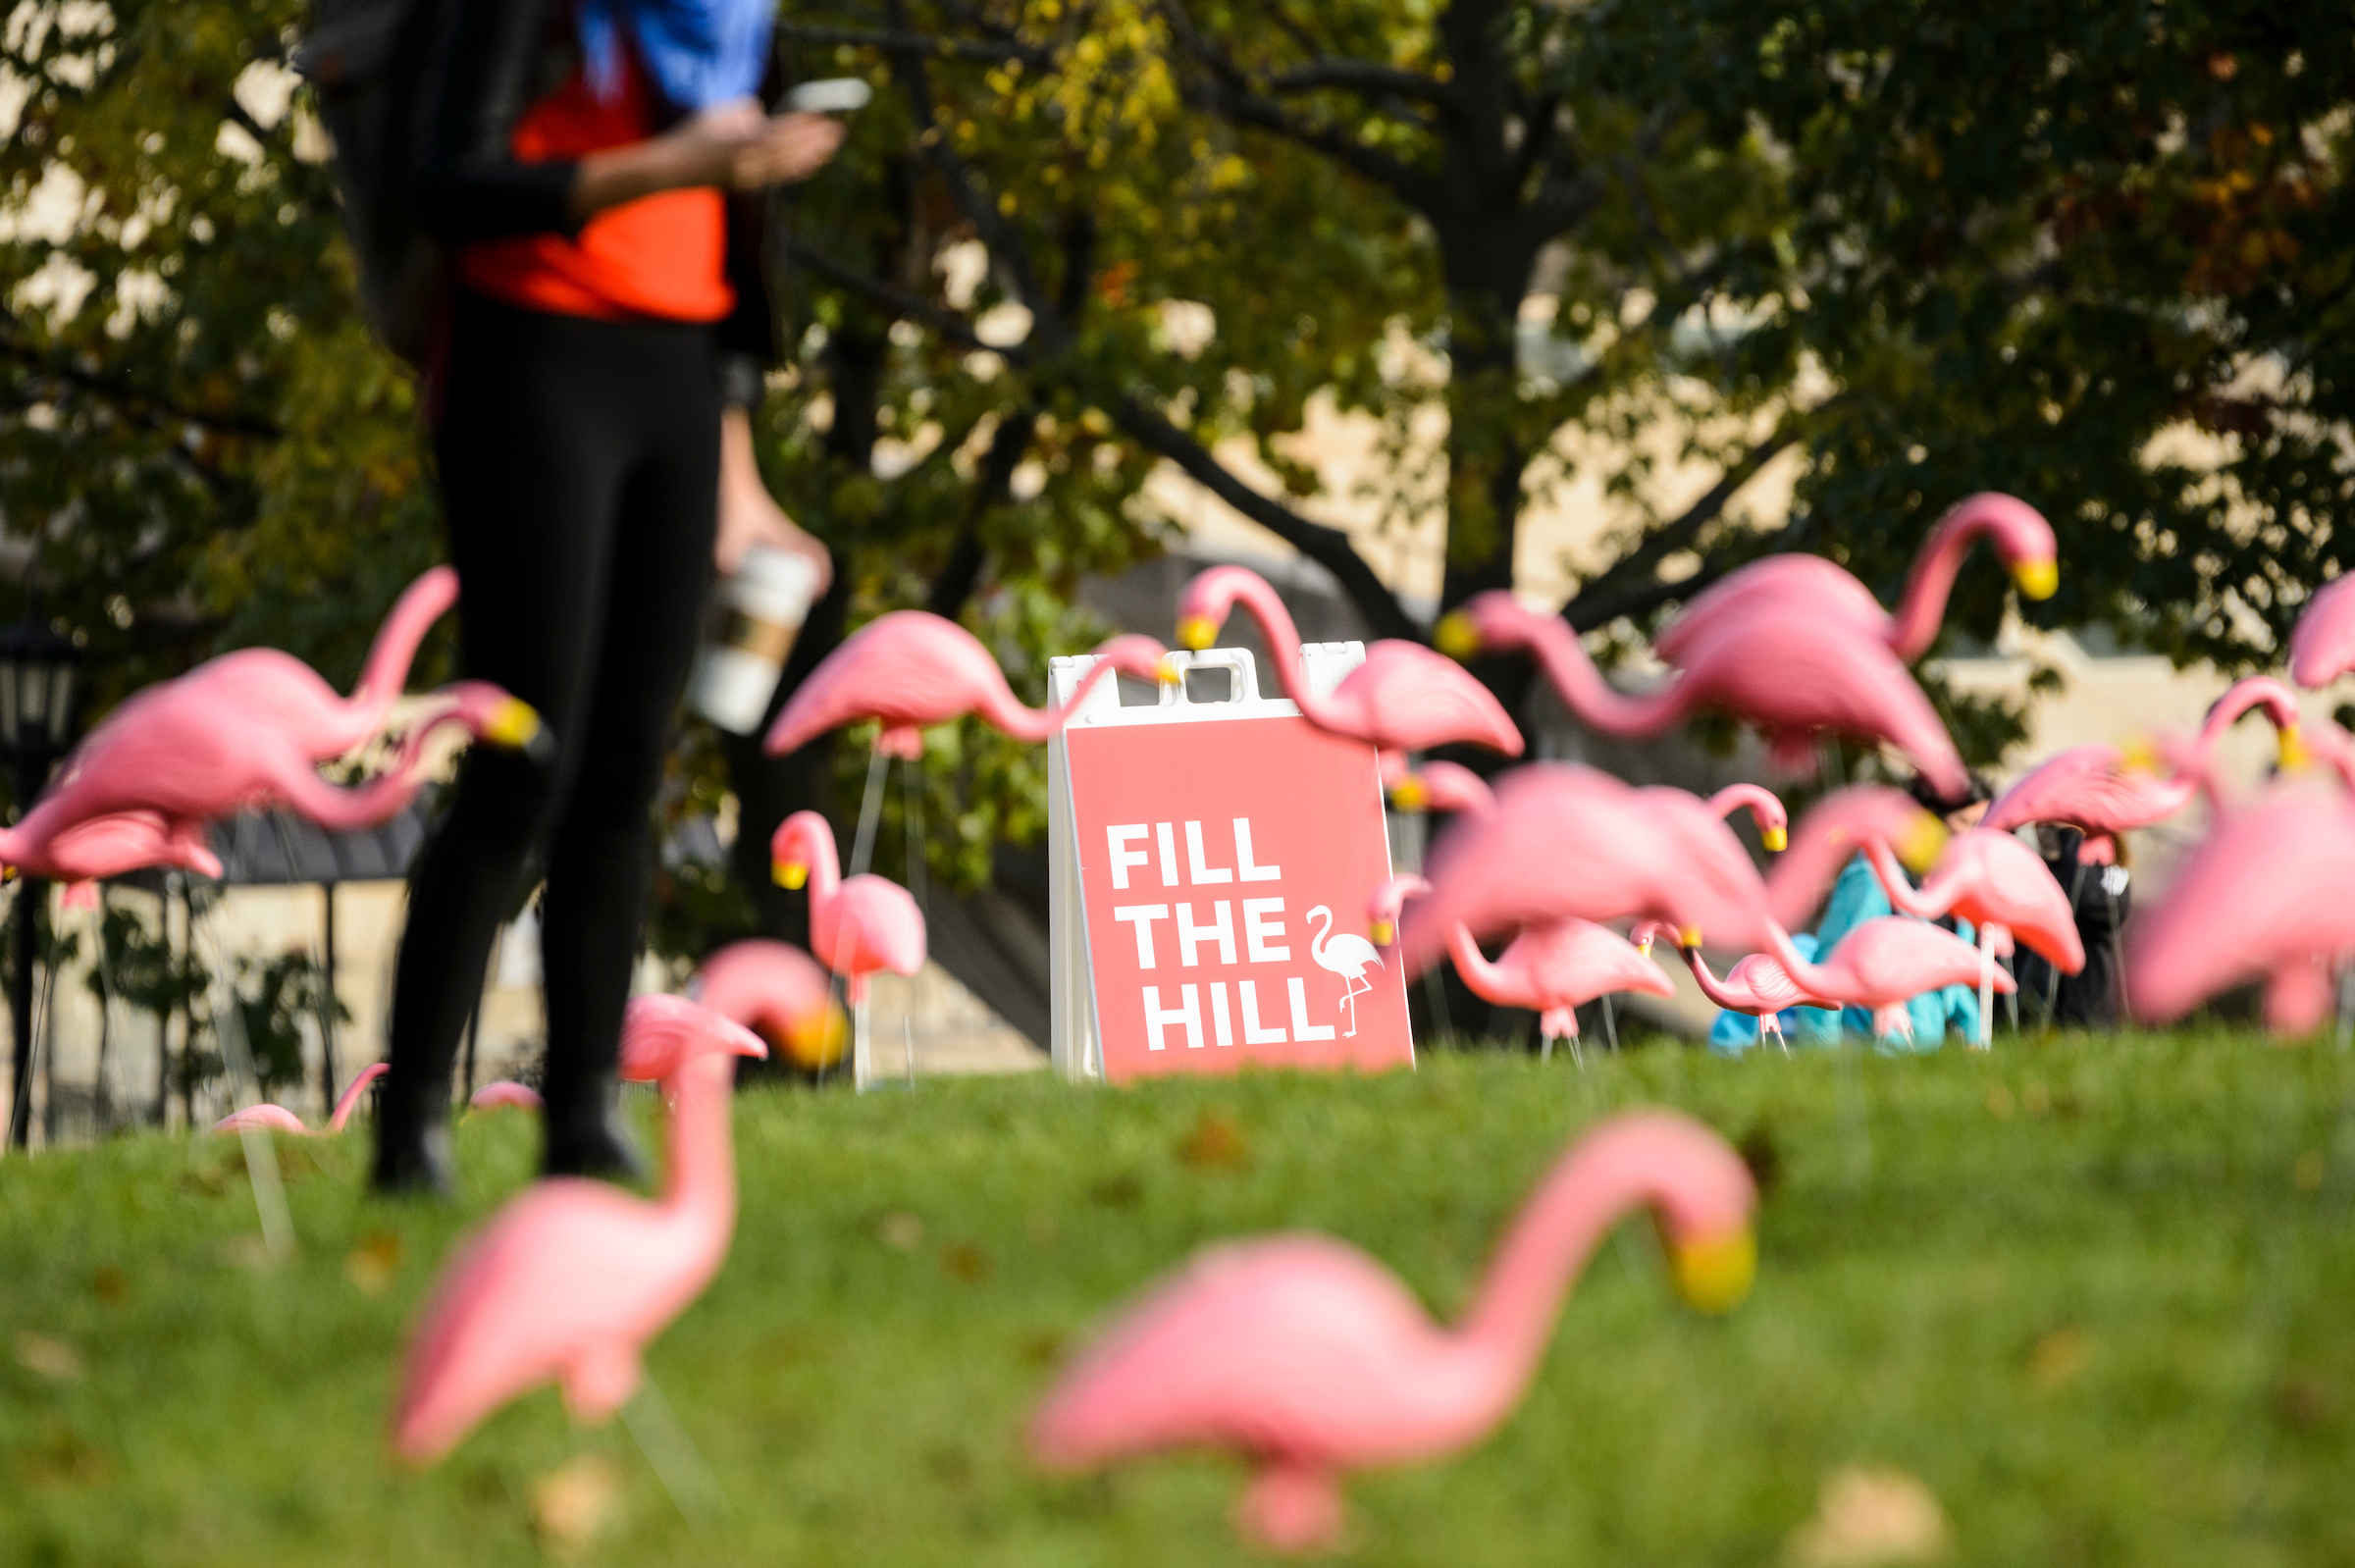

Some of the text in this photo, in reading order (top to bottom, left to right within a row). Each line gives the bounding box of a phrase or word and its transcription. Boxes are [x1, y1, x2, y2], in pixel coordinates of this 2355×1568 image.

[1106, 817, 1281, 889] FILL
[1114, 897, 1290, 969] THE
[1142, 977, 1335, 1051] HILL
